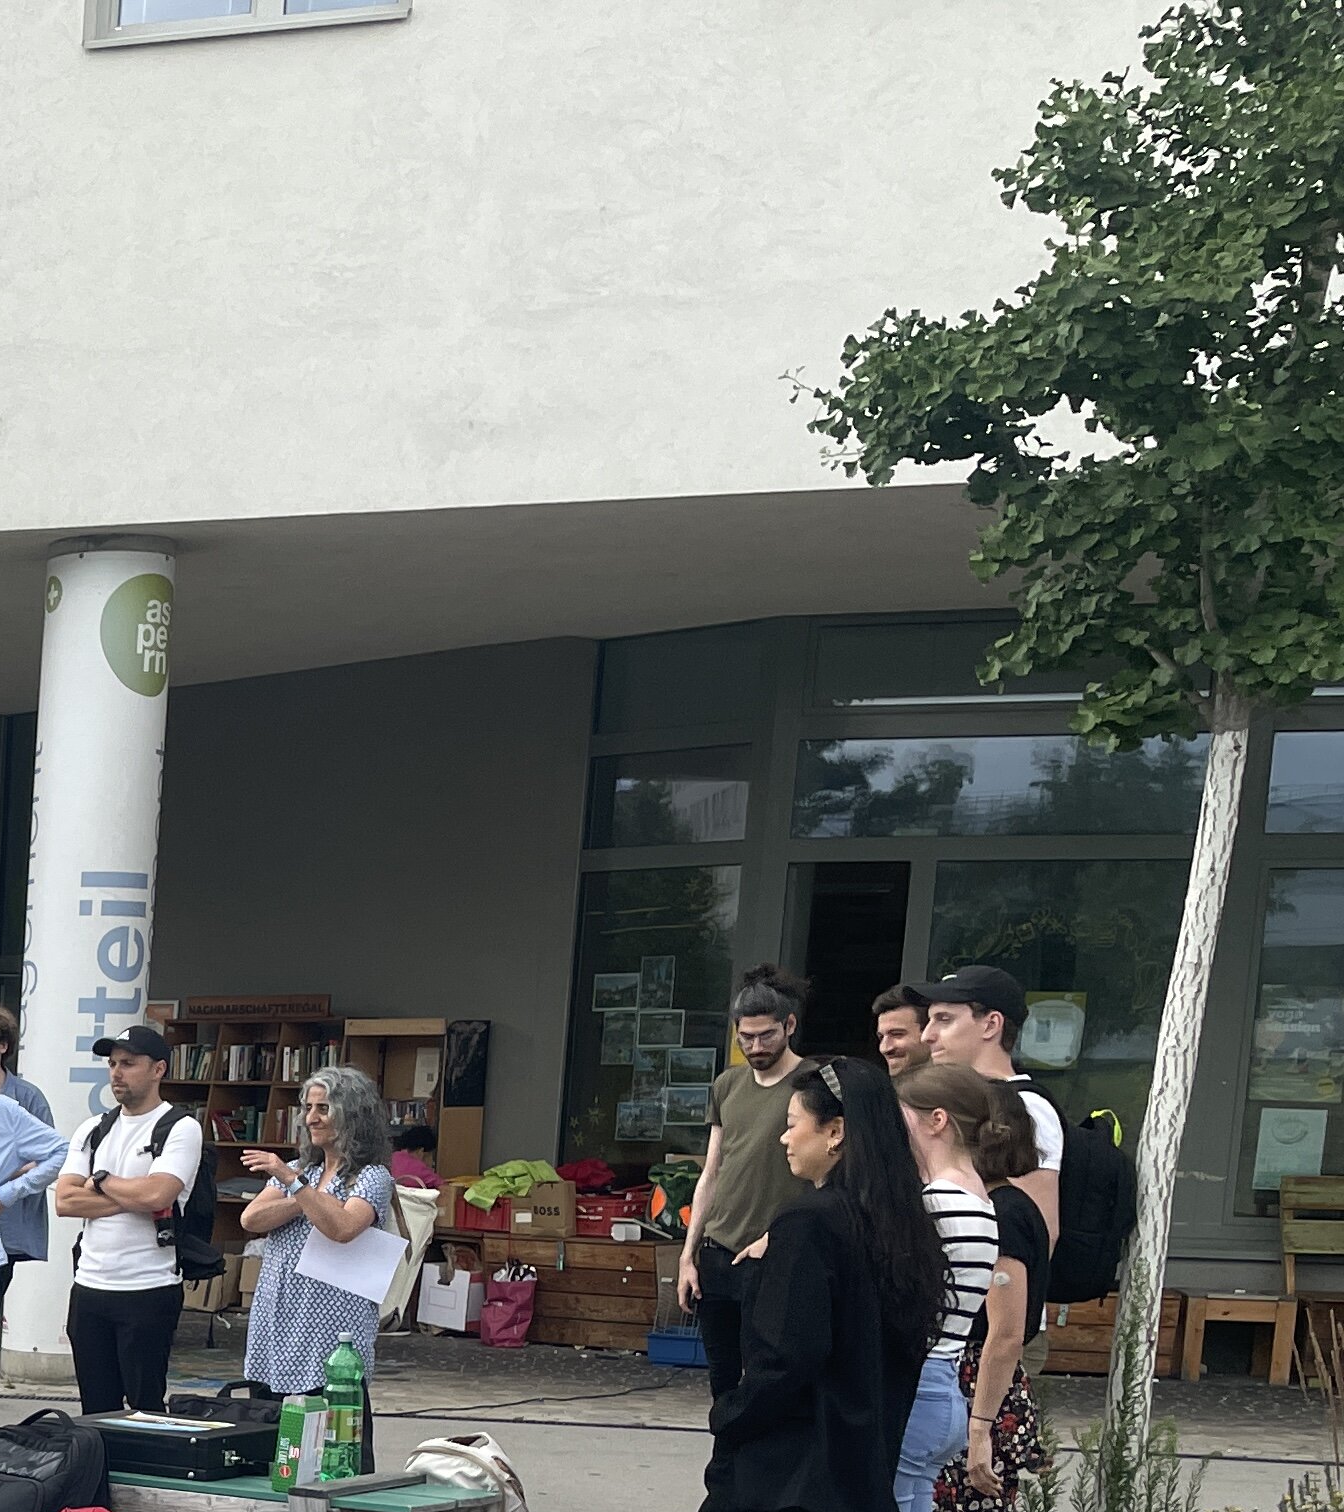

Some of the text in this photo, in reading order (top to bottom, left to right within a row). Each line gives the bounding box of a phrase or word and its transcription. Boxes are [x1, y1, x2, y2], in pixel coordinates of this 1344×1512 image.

[145, 599, 172, 626] as
[136, 623, 168, 655] pe
[143, 649, 166, 675] rn
